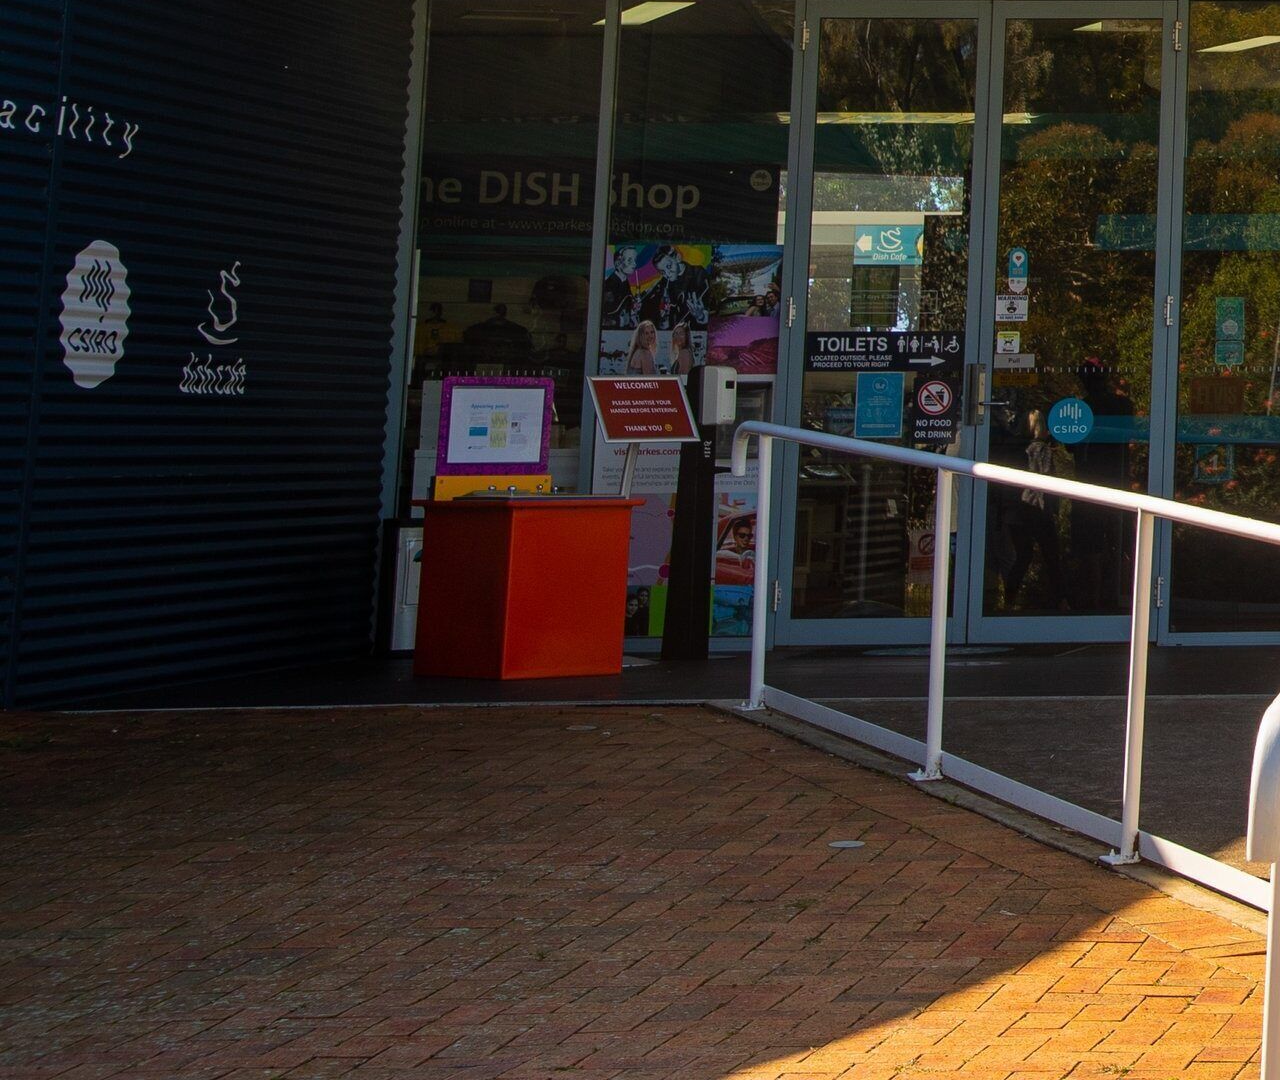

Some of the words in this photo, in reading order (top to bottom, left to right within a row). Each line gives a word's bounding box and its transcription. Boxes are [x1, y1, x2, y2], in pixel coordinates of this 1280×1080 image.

[479, 170, 580, 207] DISH
[67, 327, 118, 354] CSIRO
[817, 337, 888, 352] TOILETS
[614, 381, 660, 390] WELCOME!!
[916, 419, 928, 427] NO
[929, 419, 952, 427] FOOD
[1053, 424, 1088, 434] CSIRO
[914, 431, 927, 439] OR
[928, 431, 952, 439] DRINK
